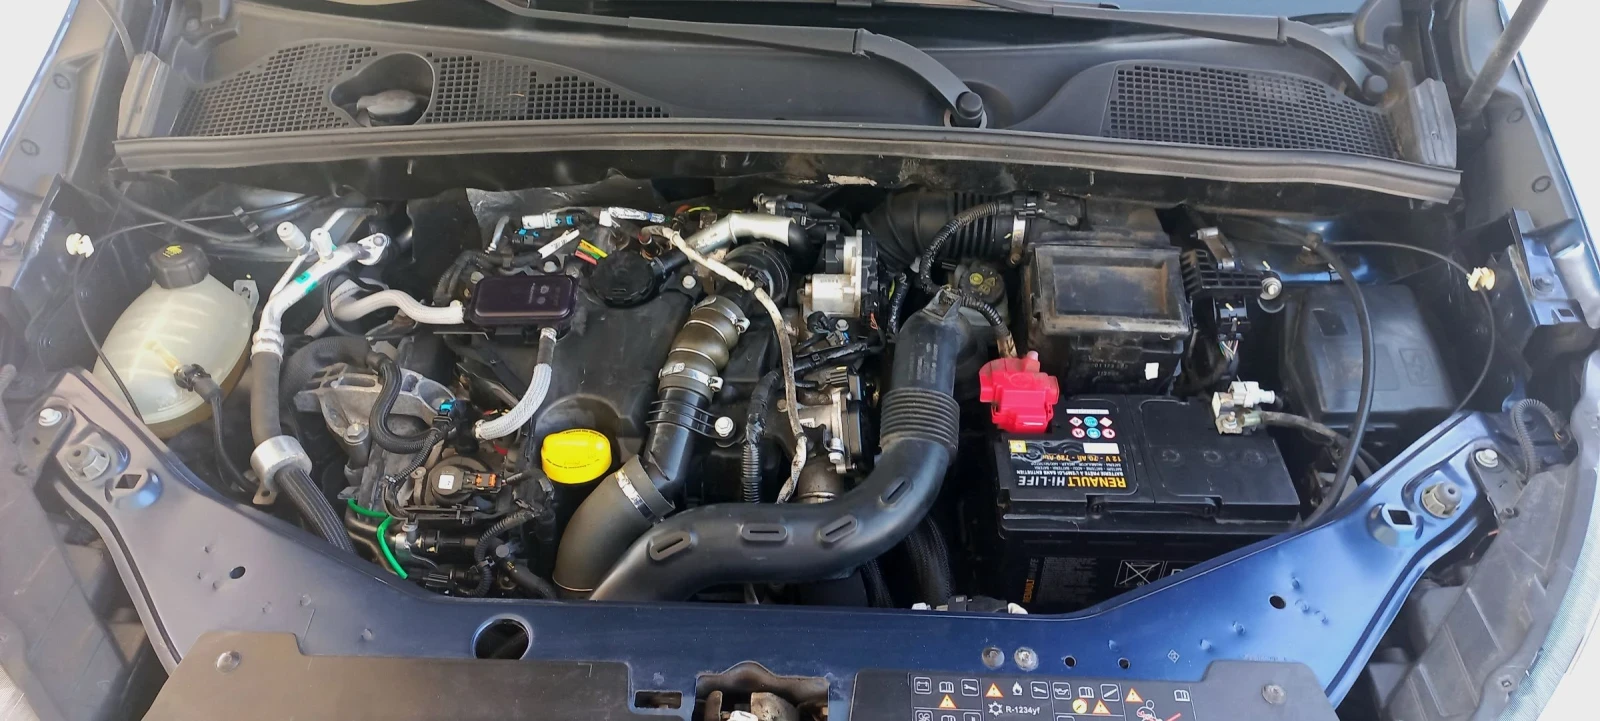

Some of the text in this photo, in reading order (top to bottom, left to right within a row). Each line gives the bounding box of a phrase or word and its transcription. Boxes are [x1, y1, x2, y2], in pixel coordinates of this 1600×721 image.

[1018, 476, 1126, 488] RENAULT Hi-LIFE
[1005, 706, 1040, 715] R-1234yf
